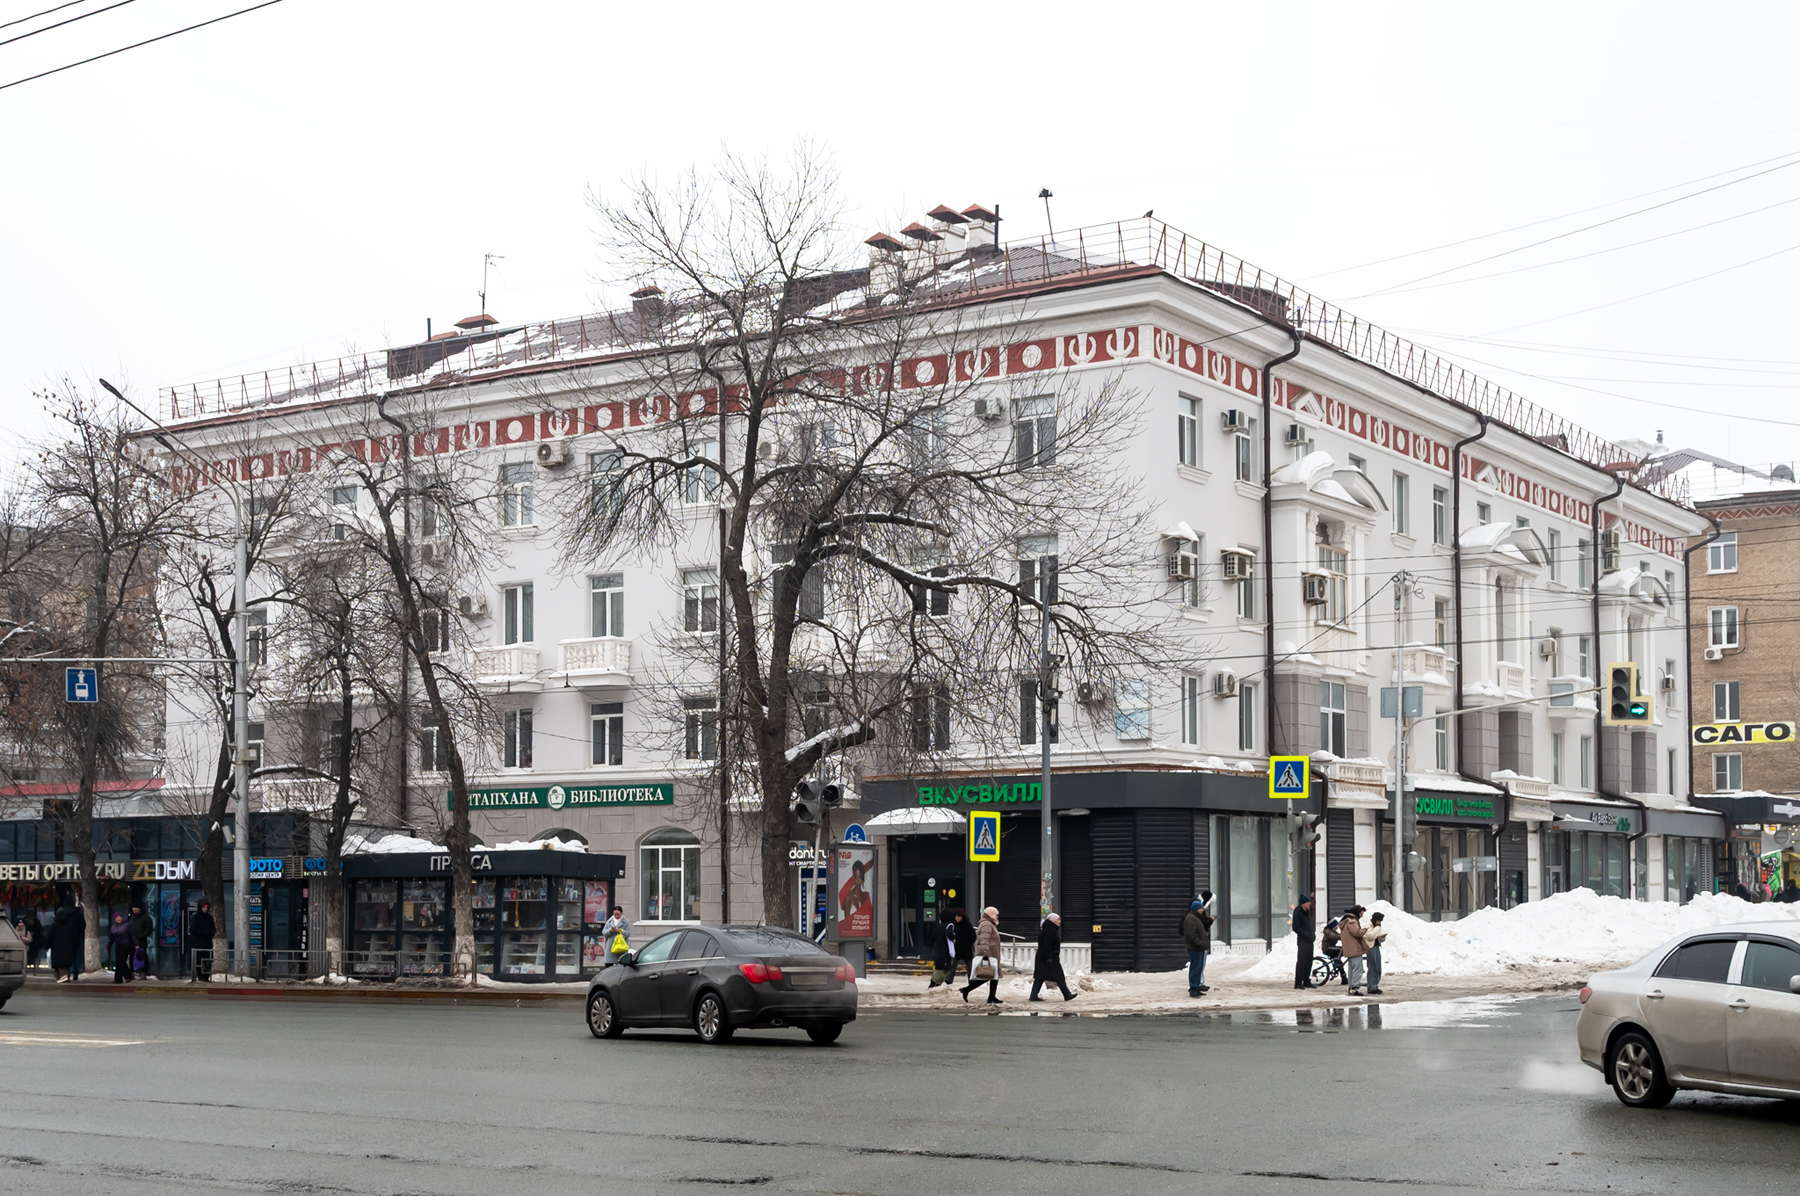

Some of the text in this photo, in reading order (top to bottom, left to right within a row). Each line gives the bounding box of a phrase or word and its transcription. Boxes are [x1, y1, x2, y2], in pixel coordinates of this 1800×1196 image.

[1694, 723, 1791, 743] САГО
[467, 791, 539, 806] ИТАПХАНА
[570, 787, 664, 803] БИБЛИОТЕКА
[919, 782, 1042, 804] ВКУСВИЛЛ
[1416, 797, 1453, 815] УСВИЛЛ
[430, 855, 492, 871] ПРСА
[0, 864, 39, 880] ВЕТЫ
